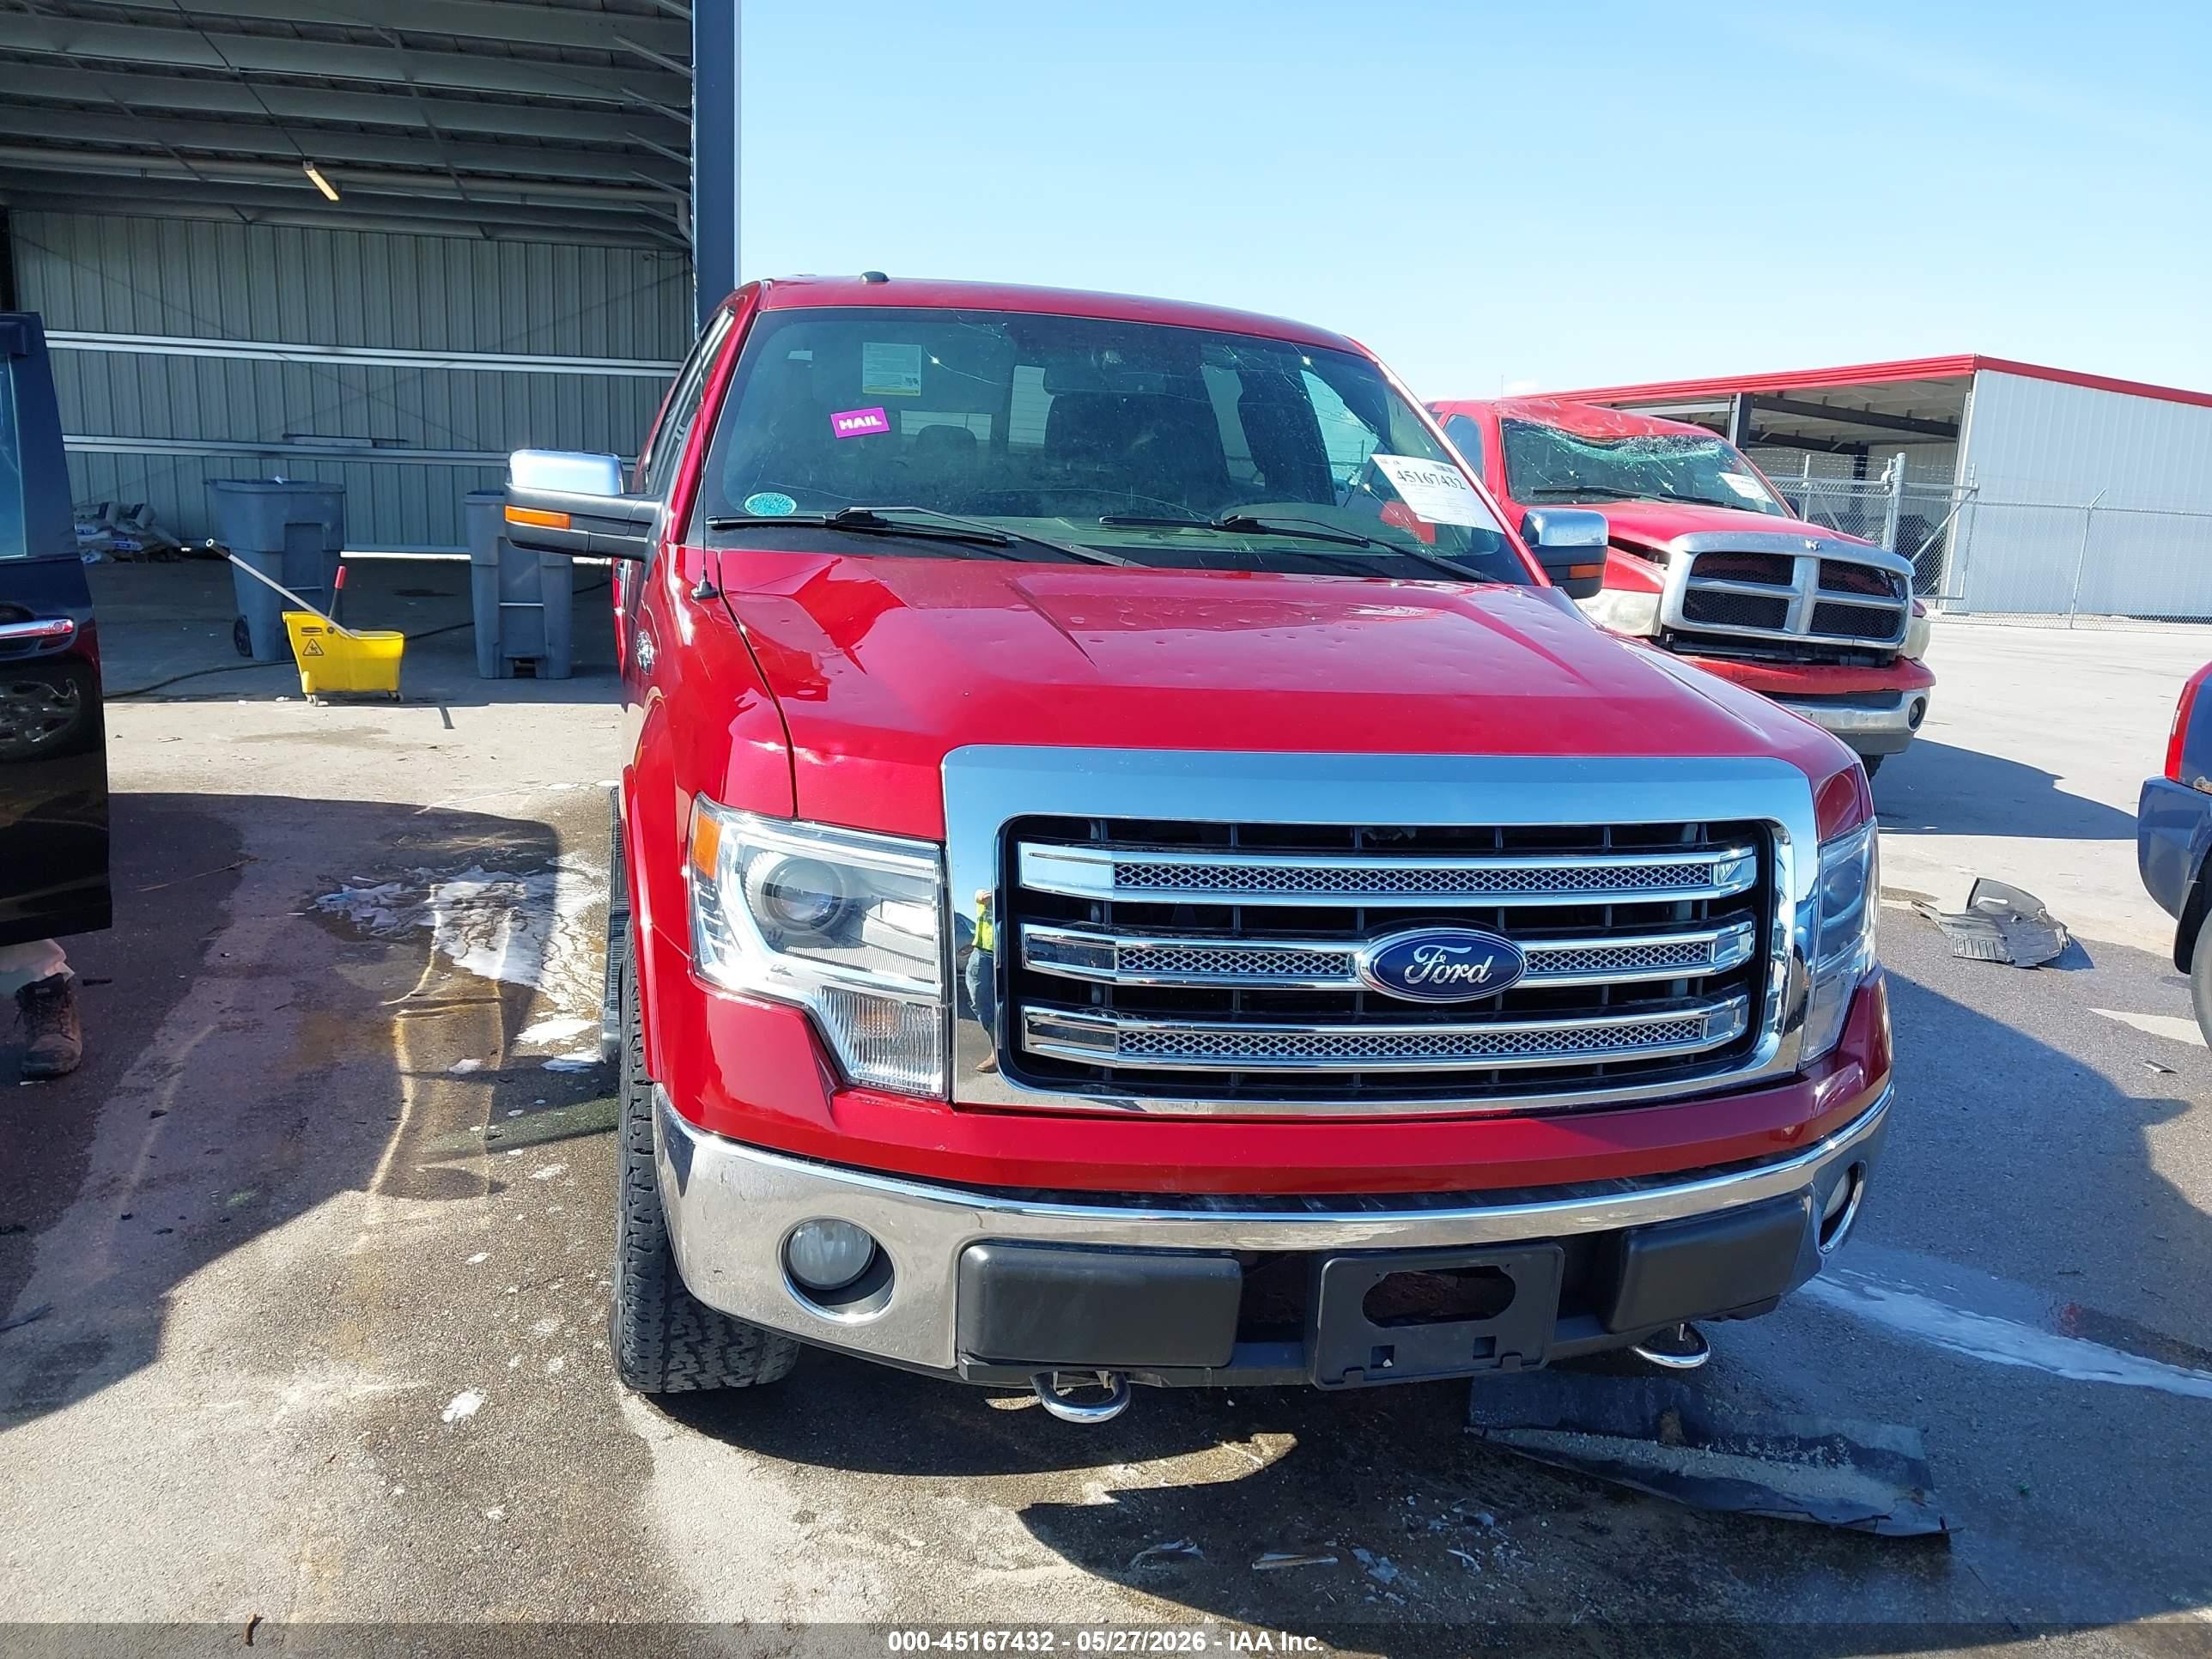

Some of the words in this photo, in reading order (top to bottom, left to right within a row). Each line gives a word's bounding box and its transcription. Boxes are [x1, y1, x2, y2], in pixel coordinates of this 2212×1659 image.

[838, 415, 883, 430] HAIL
[1396, 470, 1467, 490] 45167432
[1404, 945, 1494, 984] Ford
